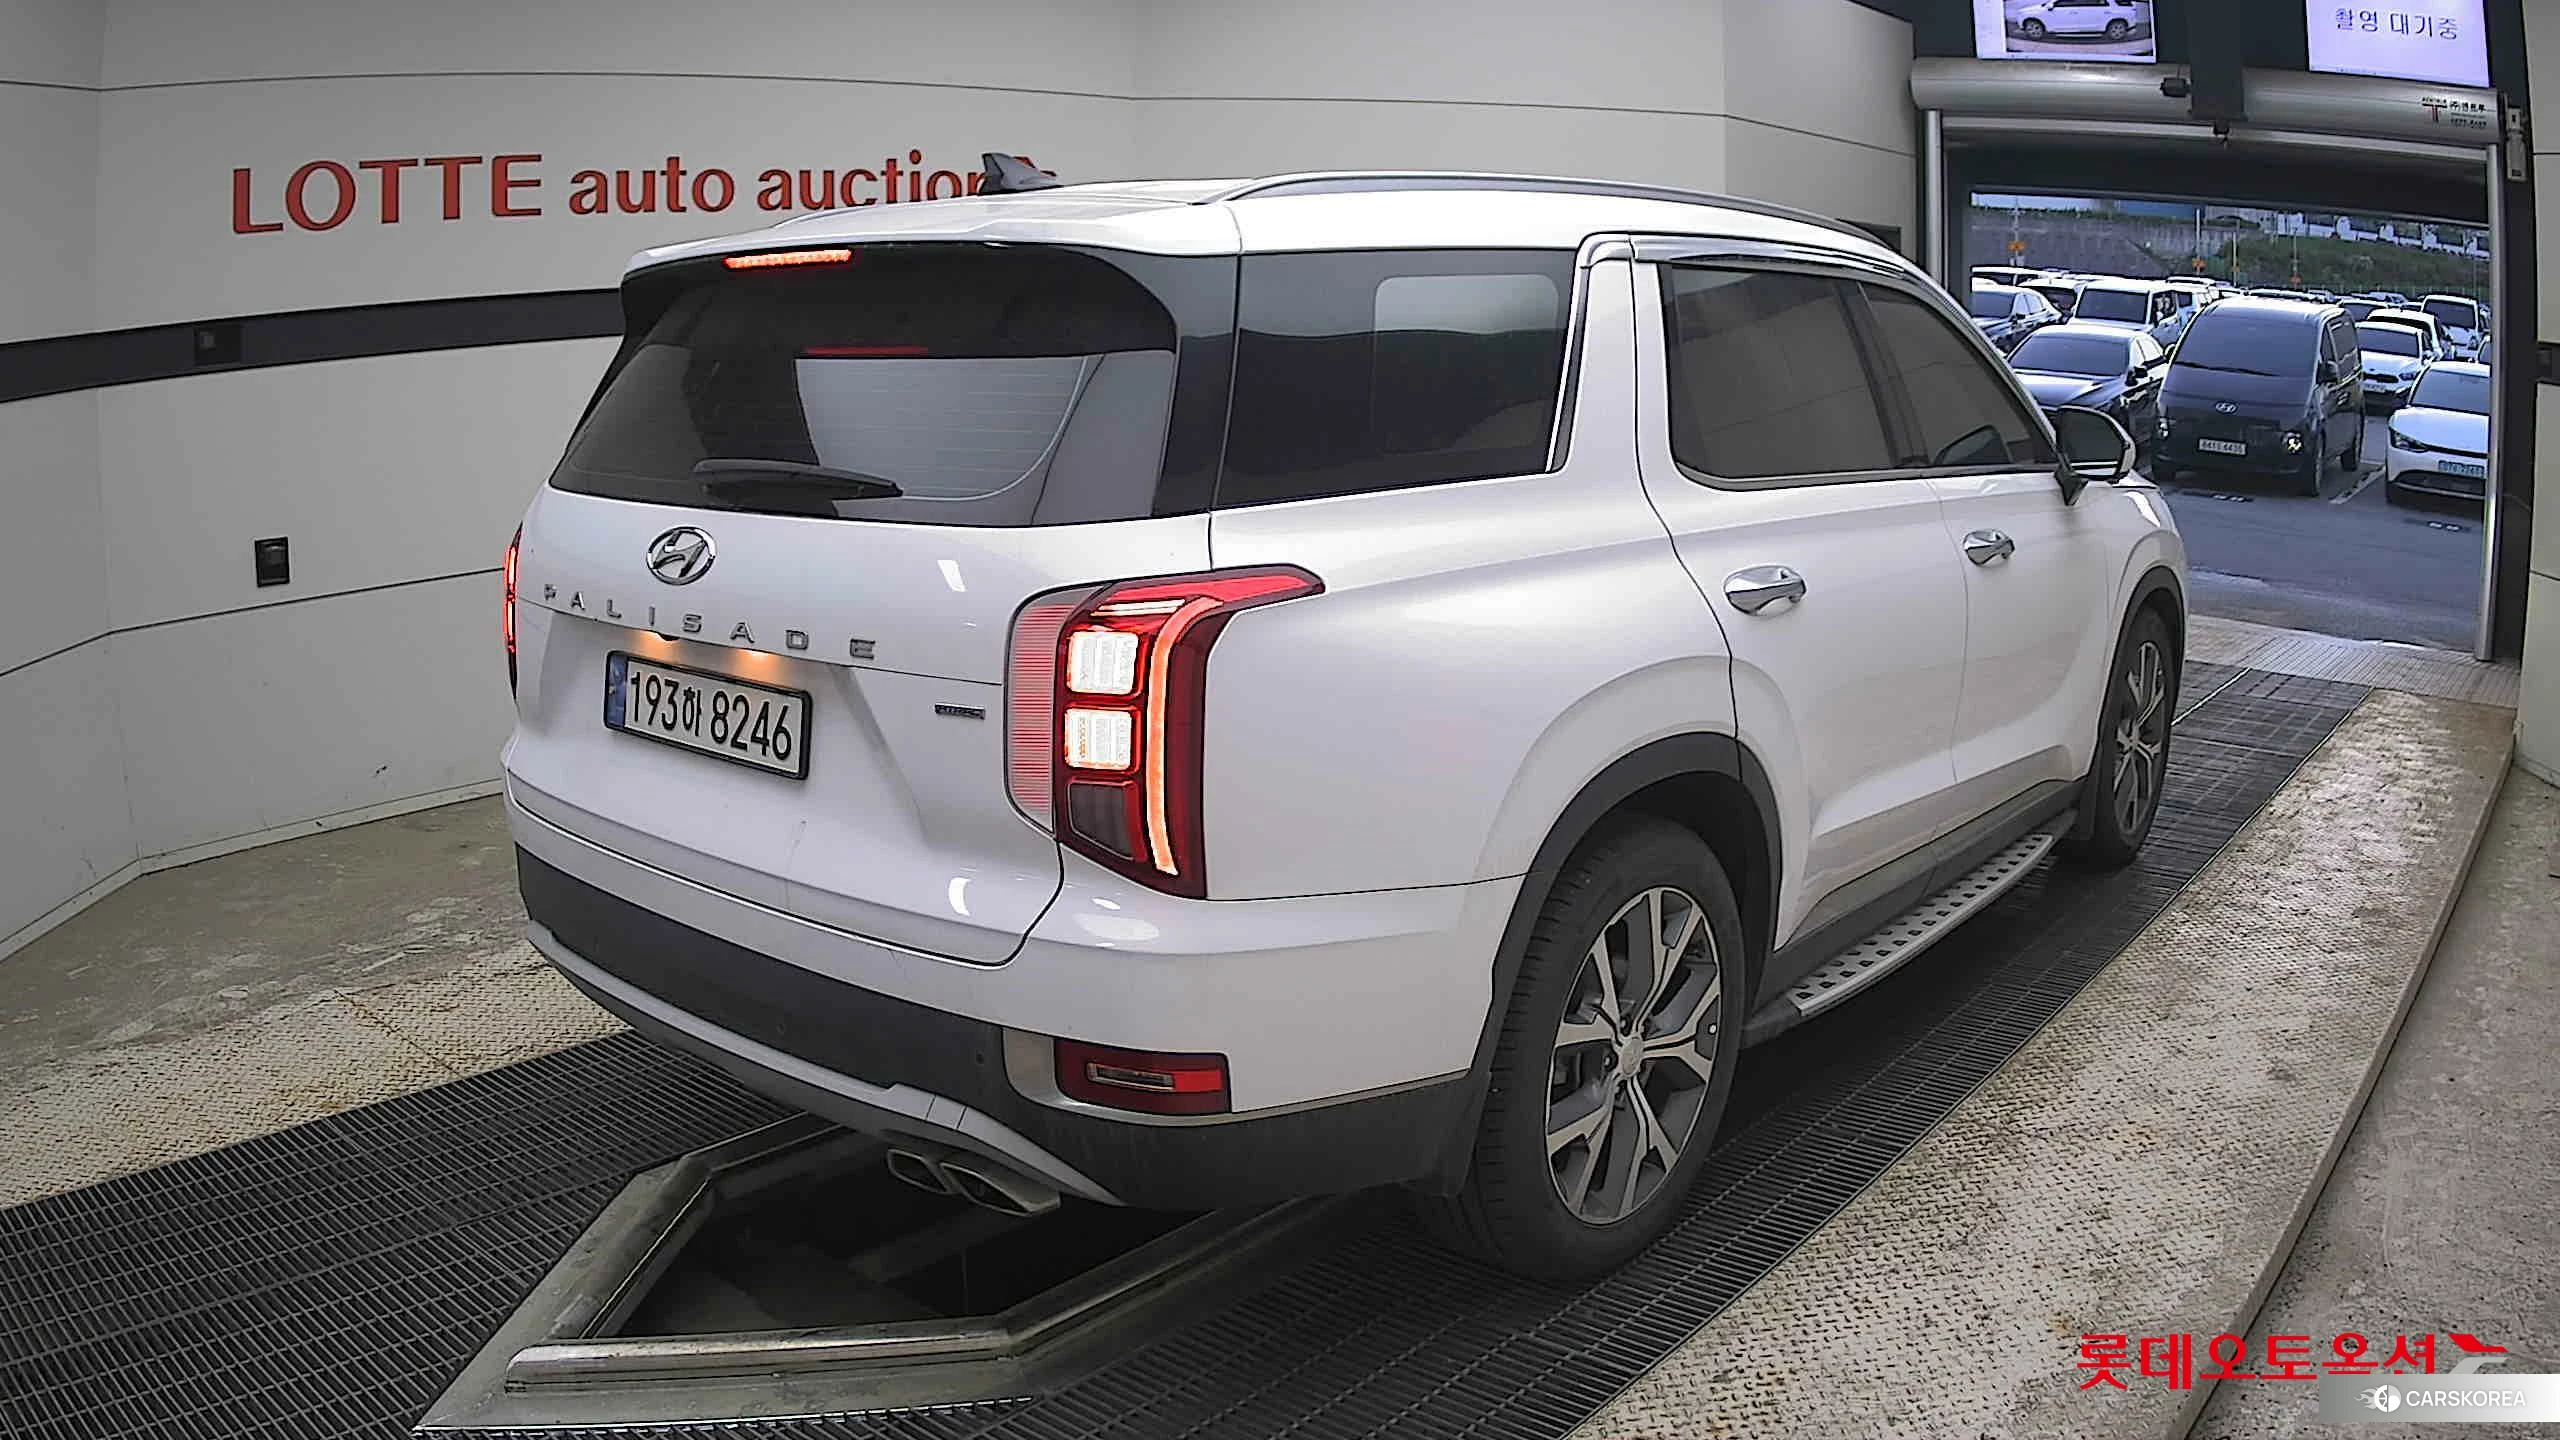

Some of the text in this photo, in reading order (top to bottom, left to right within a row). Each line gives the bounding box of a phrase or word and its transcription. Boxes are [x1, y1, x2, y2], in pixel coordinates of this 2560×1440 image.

[2336, 8, 2457, 40] 촬영 대기중
[233, 155, 542, 234] LOTTE
[569, 156, 735, 216] auto
[544, 584, 876, 660] PALISADE
[631, 672, 792, 760] 193하 8246
